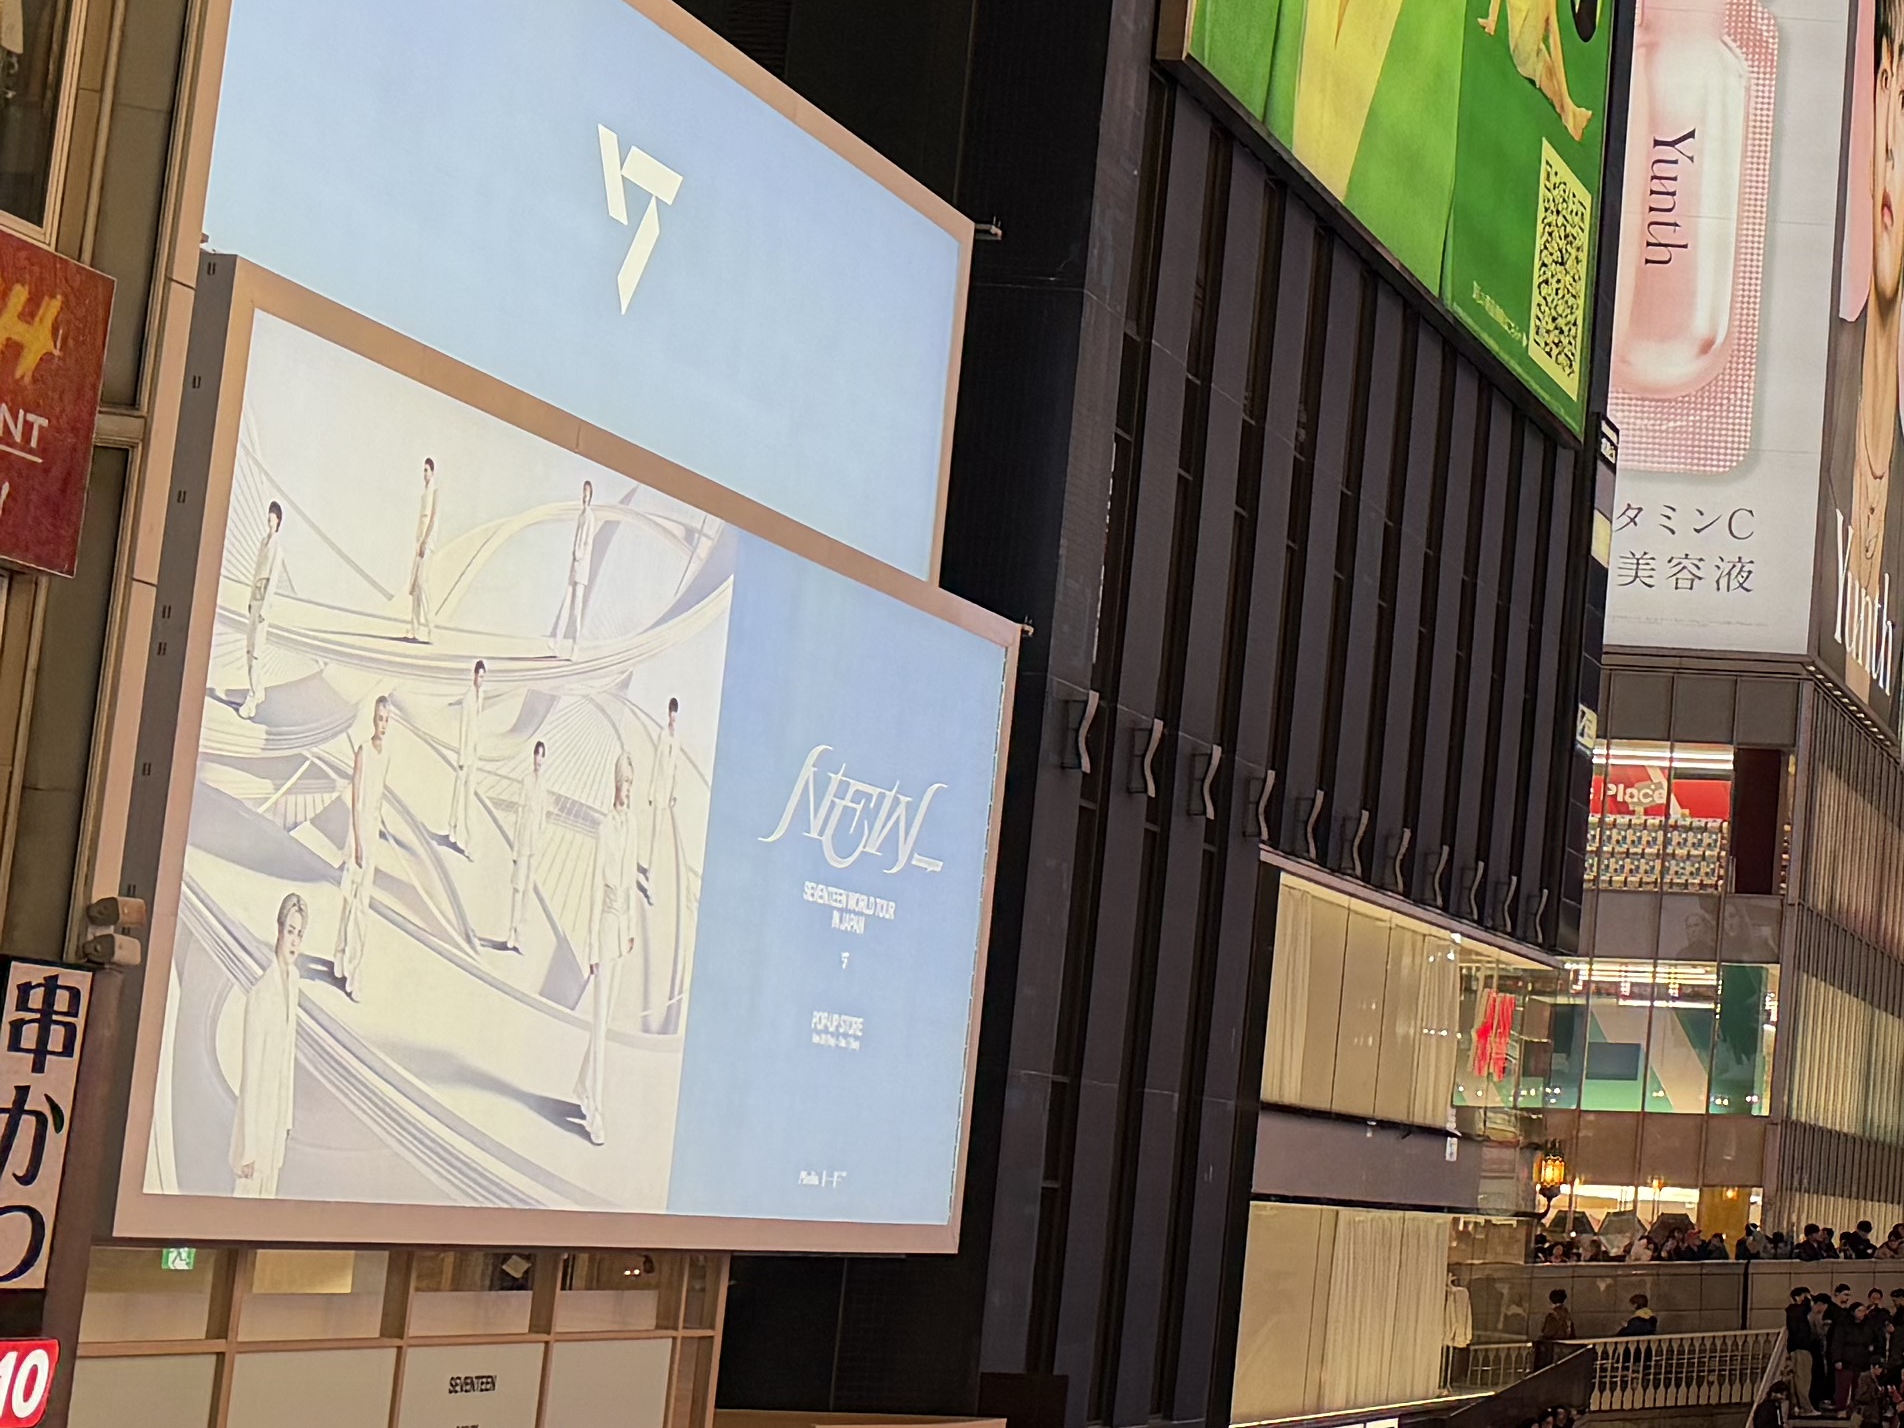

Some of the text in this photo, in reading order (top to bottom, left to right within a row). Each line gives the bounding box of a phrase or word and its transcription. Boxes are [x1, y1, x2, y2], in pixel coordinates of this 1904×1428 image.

[1643, 125, 1698, 270] Yunth
[1615, 550, 1755, 594] 美容液
[1830, 505, 1895, 701] Yunth
[448, 1374, 498, 1395] SEVENTEEN
